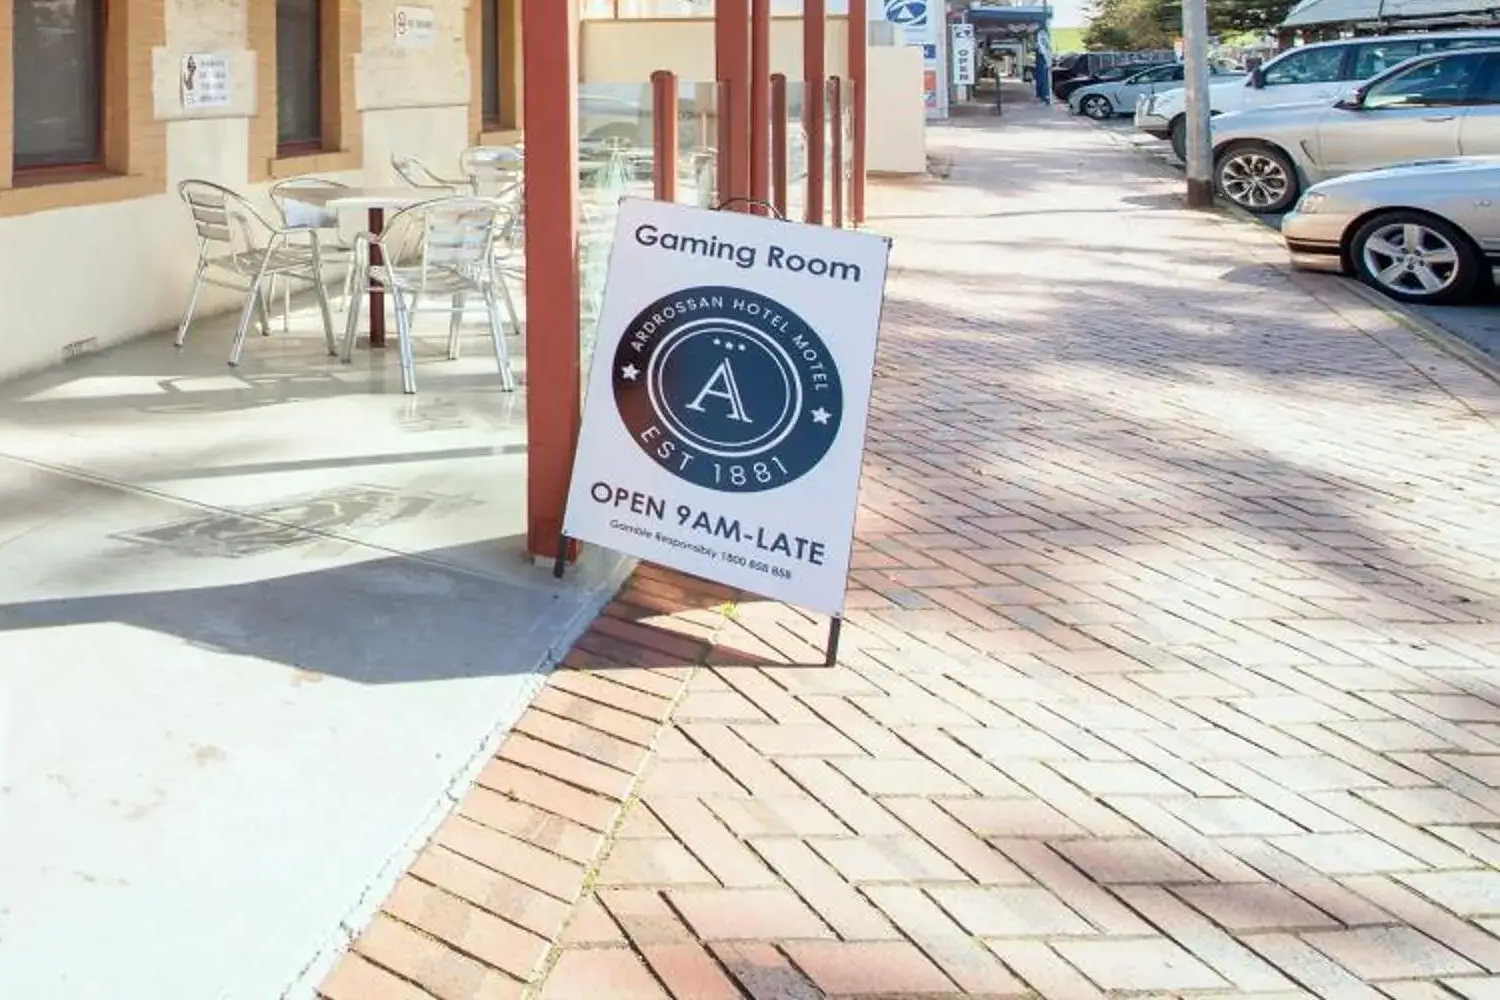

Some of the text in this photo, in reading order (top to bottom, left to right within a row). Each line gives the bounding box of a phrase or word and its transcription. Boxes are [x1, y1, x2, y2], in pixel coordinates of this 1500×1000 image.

[634, 224, 861, 283] Gaming Room
[631, 296, 829, 391] ARDROSSAN HOTEL MOTEL
[684, 357, 754, 423] A
[640, 426, 788, 485] EST 1881
[591, 481, 826, 566] OPEN 9AM-LATE
[609, 519, 653, 539] Gamble
[655, 531, 717, 560] Responsibly
[721, 551, 747, 567] 1800
